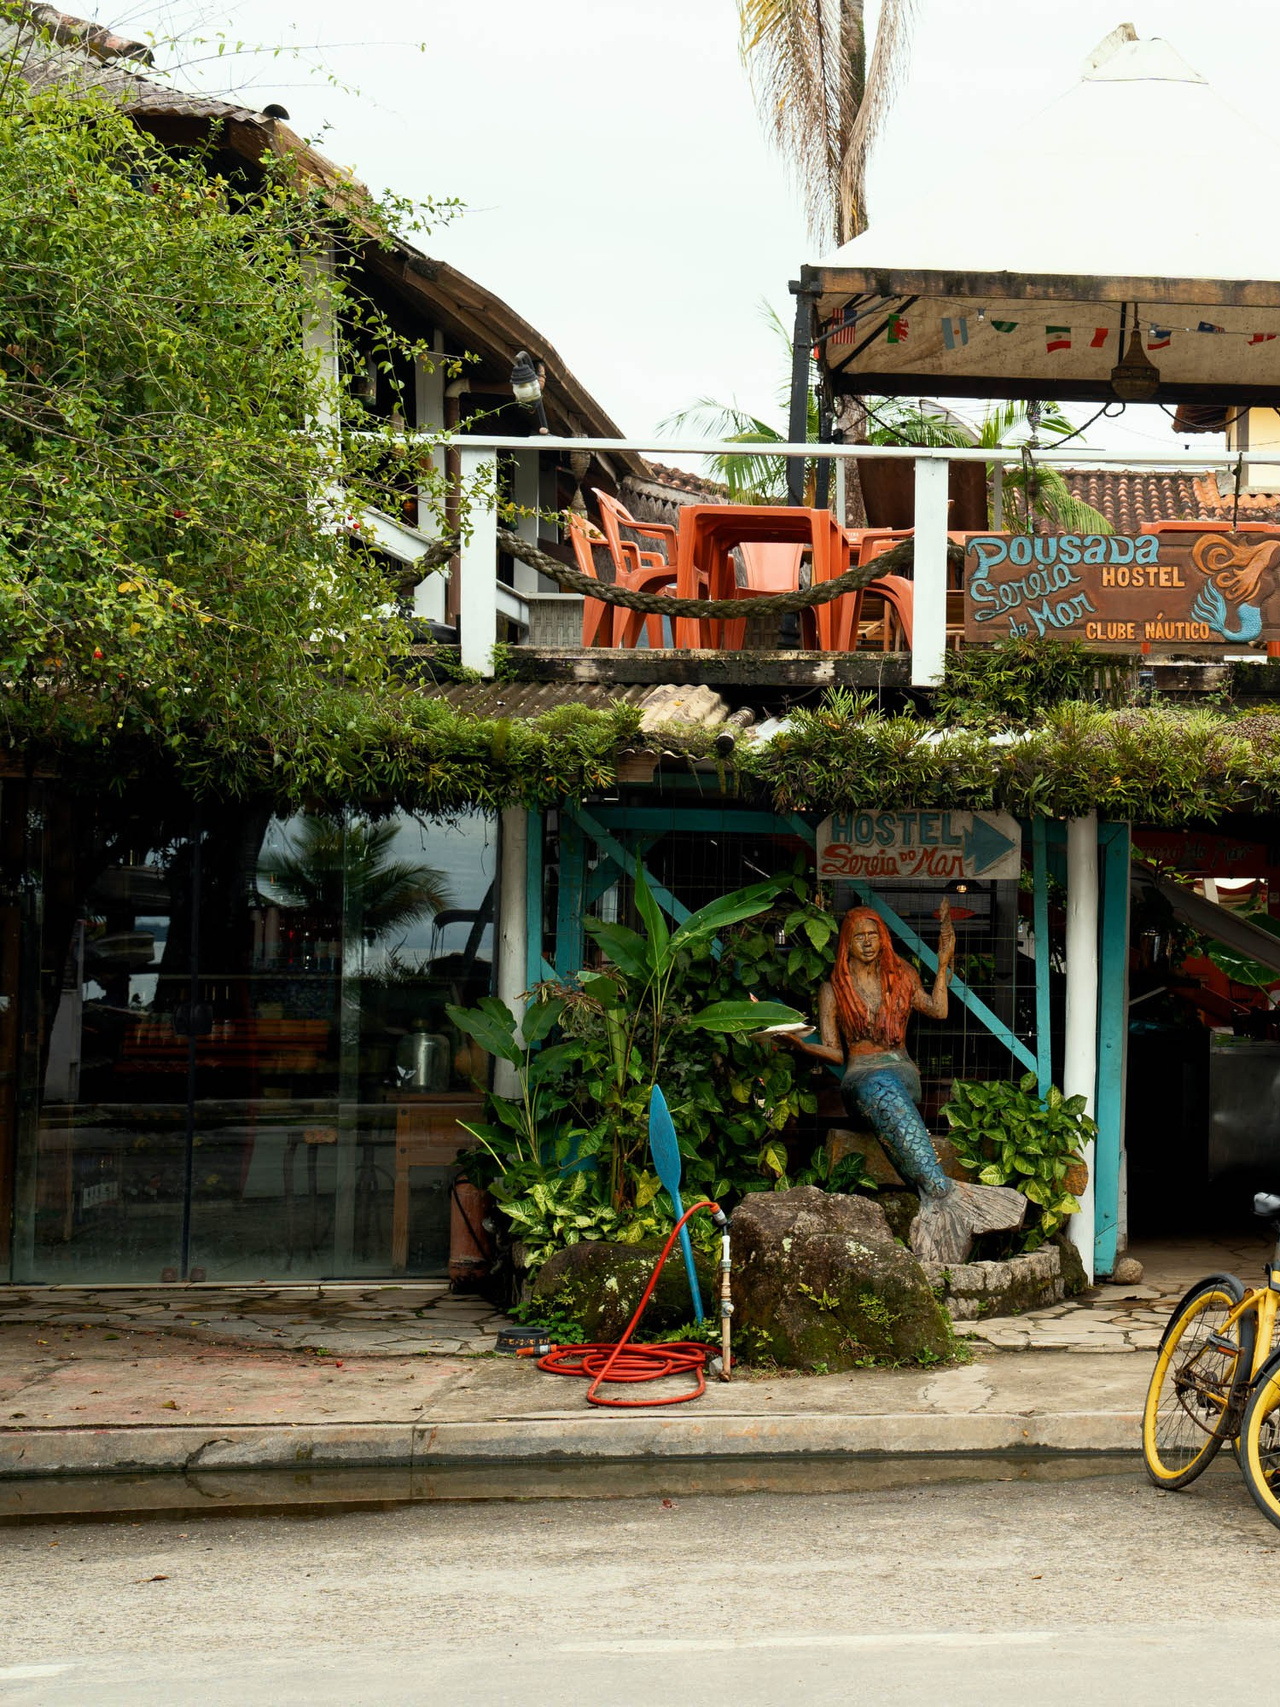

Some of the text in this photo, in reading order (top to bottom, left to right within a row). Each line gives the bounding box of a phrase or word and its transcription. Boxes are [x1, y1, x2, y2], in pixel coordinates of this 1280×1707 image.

[970, 564, 1081, 622] Sereia
[1102, 566, 1186, 588] HOSTEL
[1027, 598, 1096, 637] Mar
[1086, 613, 1210, 640] CLUBE NÁUTICO
[832, 812, 964, 846] HOSTEL
[820, 844, 900, 877] Sereia
[911, 848, 965, 878] Mar
